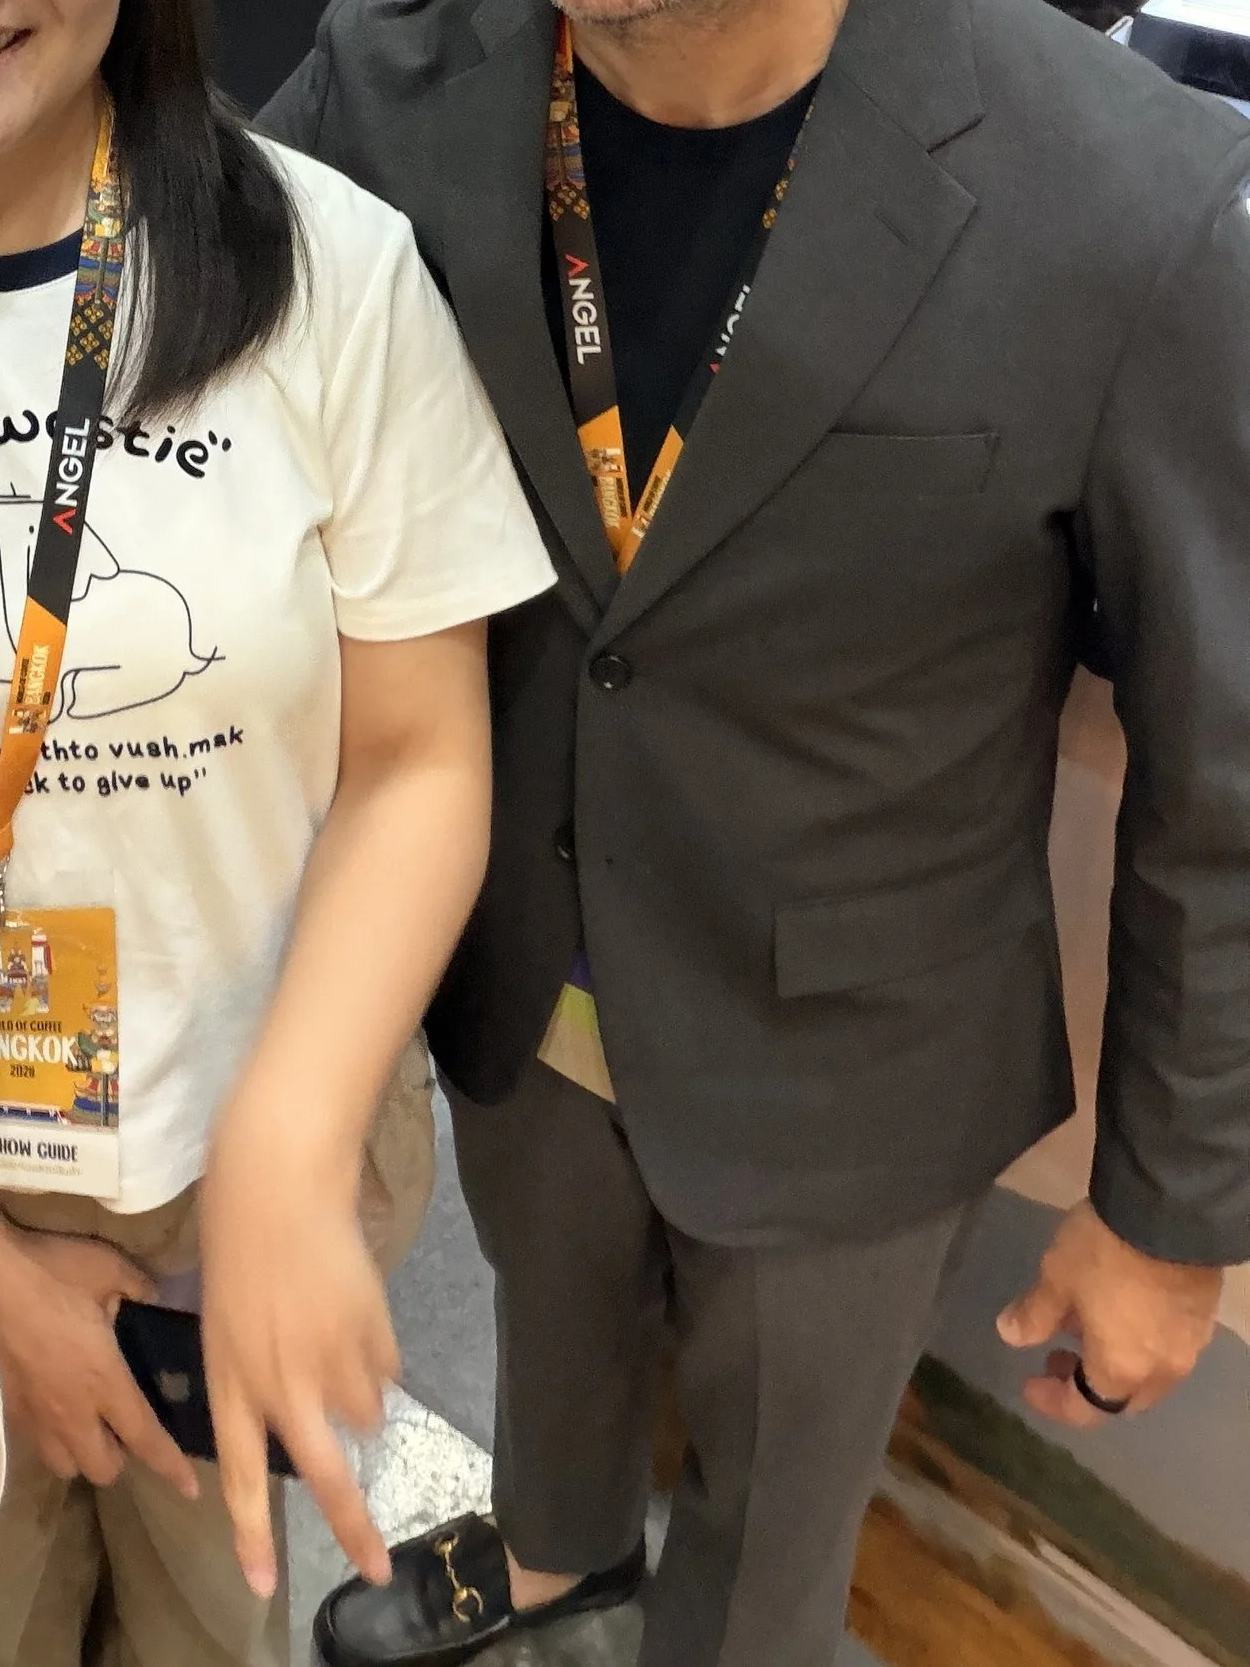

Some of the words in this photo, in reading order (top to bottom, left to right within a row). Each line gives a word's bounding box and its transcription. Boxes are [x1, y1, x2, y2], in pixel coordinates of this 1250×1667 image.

[565, 253, 602, 366] ANGEL
[53, 417, 91, 535] ANGEL
[58, 772, 86, 793] to
[37, 1140, 79, 1163] GUIDE
